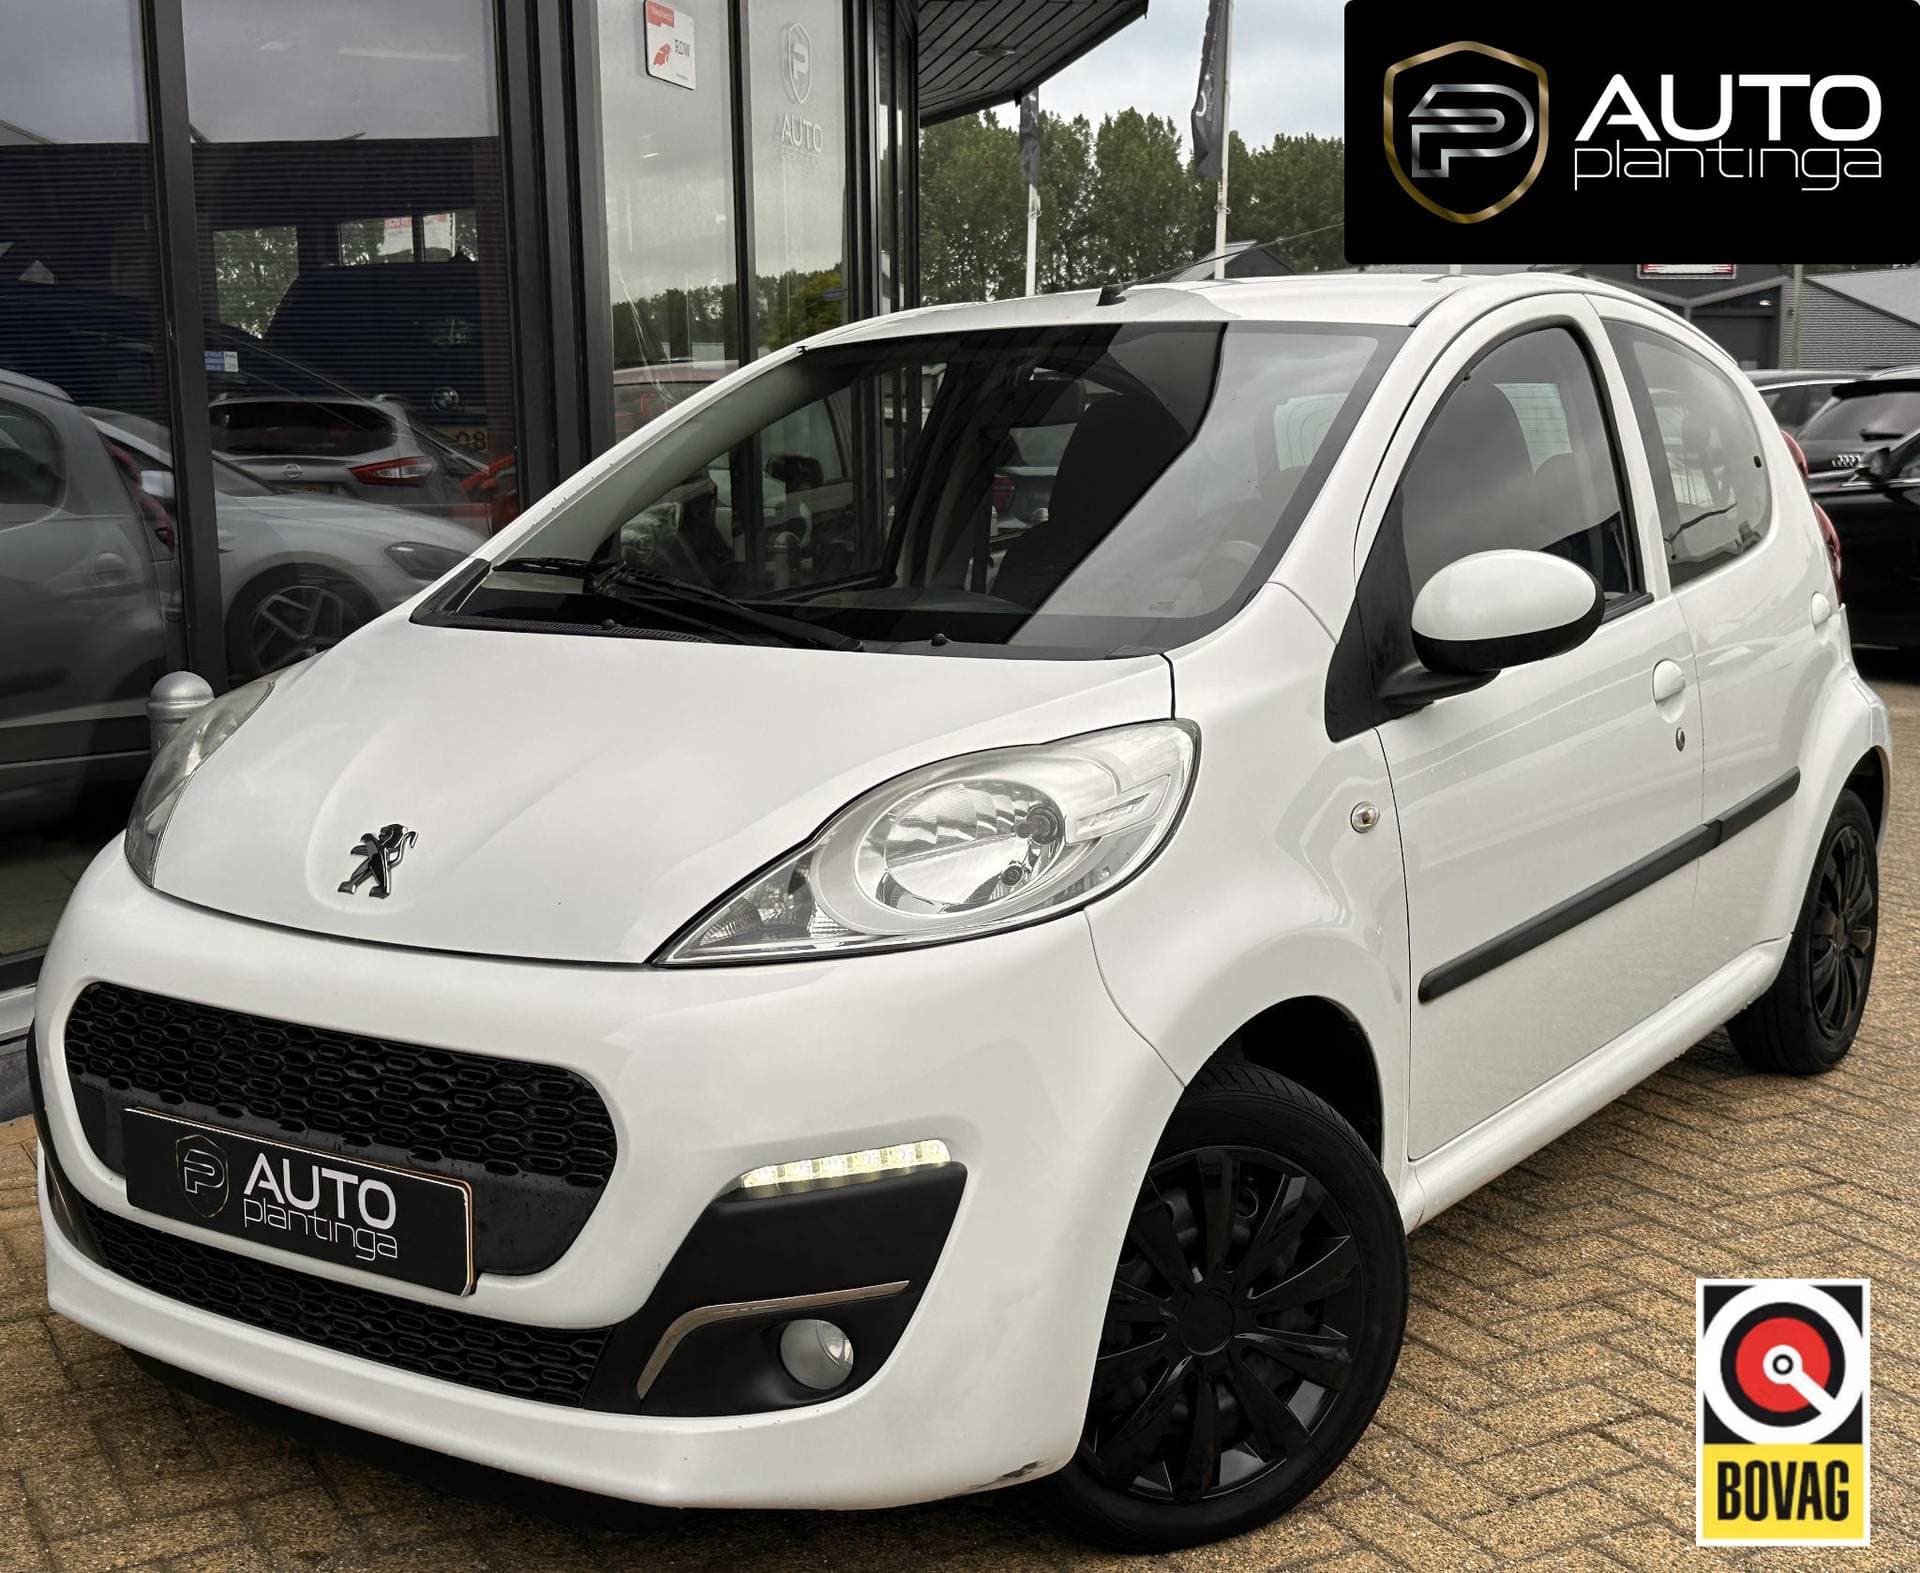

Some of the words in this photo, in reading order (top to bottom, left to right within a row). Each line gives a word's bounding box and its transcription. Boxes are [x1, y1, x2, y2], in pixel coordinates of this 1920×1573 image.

[780, 111, 823, 153] AUTO
[243, 1152, 397, 1230] AUTO
[243, 1197, 398, 1262] plantinga
